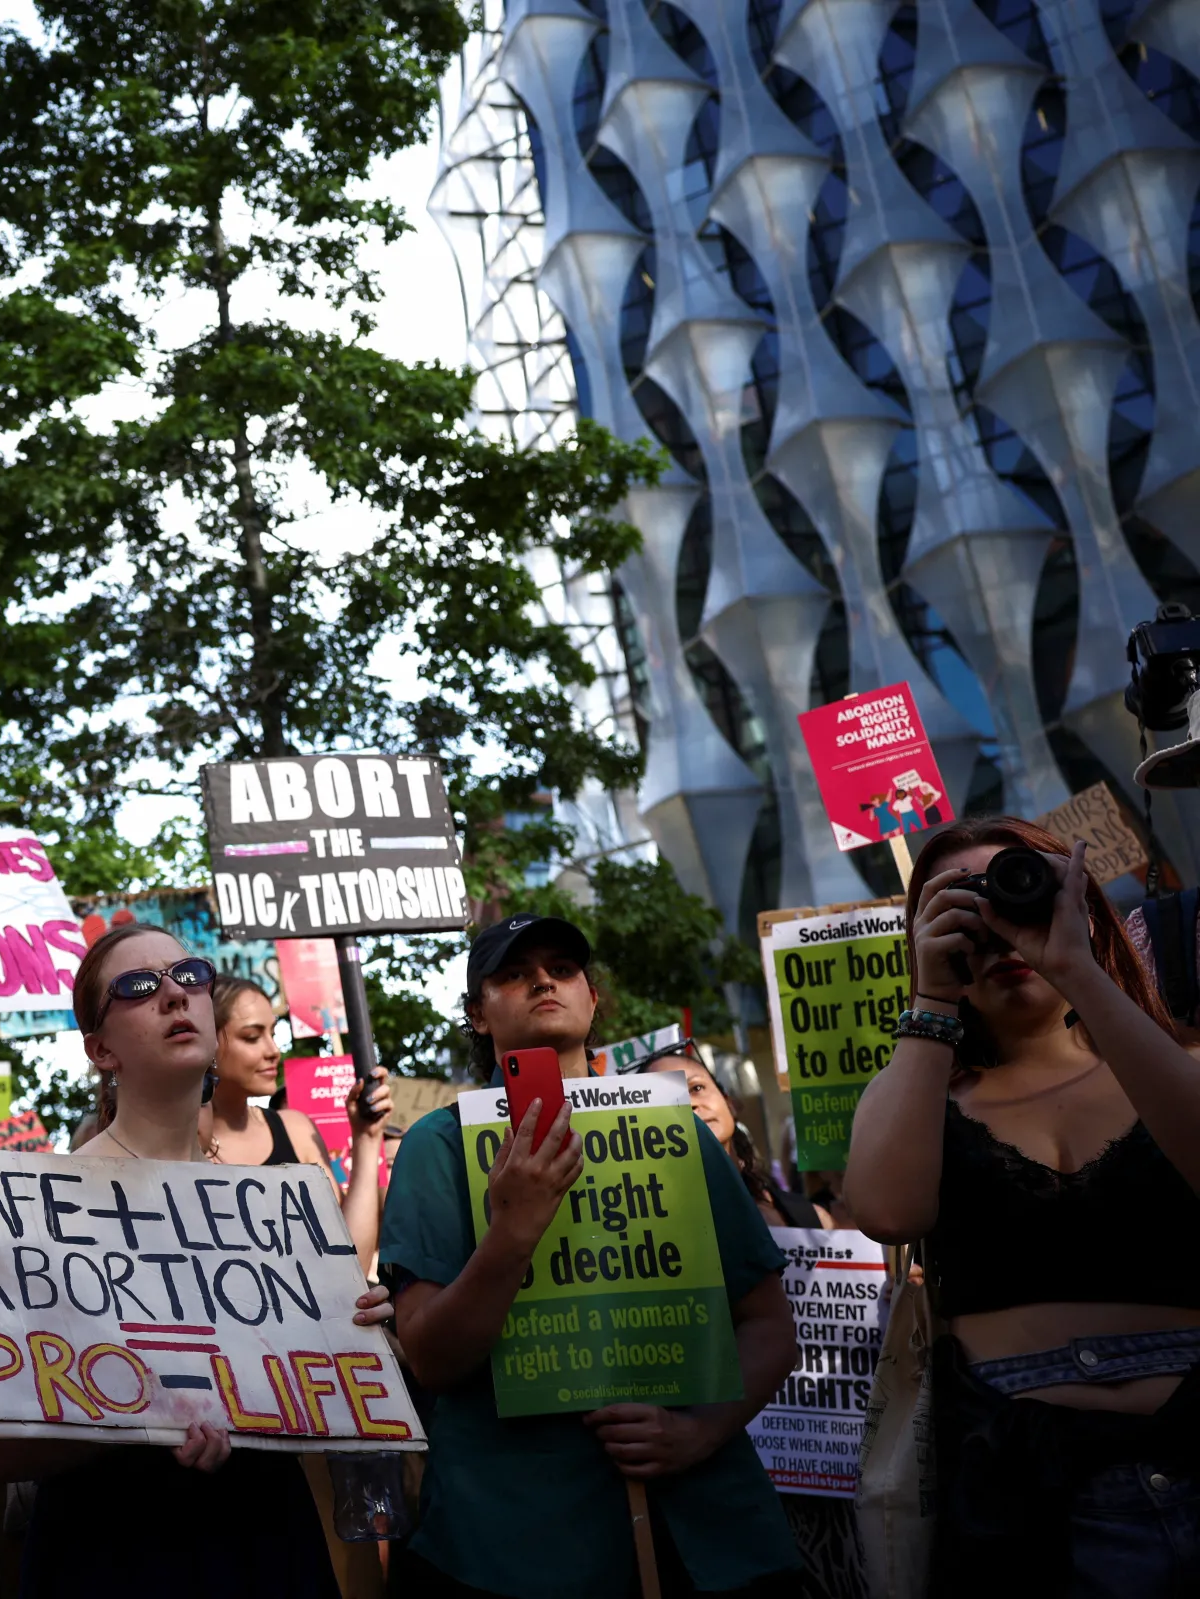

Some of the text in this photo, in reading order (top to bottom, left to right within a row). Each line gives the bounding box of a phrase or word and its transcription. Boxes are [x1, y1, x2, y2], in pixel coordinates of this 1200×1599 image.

[837, 694, 905, 723] ABORTION
[860, 705, 908, 728] RIGHTS
[836, 717, 911, 747] SOLIDARITY
[866, 727, 916, 750] MARCH
[229, 757, 431, 824] ABORT
[309, 828, 365, 858] THE
[799, 915, 907, 943] Socialist Work
[784, 952, 836, 989] Our
[790, 996, 842, 1033] Our
[796, 1043, 827, 1079] to
[576, 1086, 652, 1109] Worker
[583, 1115, 689, 1164] odies
[804, 1120, 846, 1145] right
[569, 1172, 668, 1232] right
[550, 1230, 682, 1286] decide
[810, 1281, 823, 1298] A
[827, 1282, 878, 1300] MASS
[588, 1309, 601, 1331] a
[610, 1296, 709, 1329] woman's
[843, 1326, 882, 1344] FOR
[504, 1338, 685, 1380] right to choose
[573, 1381, 680, 1400] socialistworker.co.uk
[762, 1416, 864, 1437] DEFEND THE RIGHT
[789, 1437, 823, 1454] WHEN
[825, 1438, 849, 1456] AND
[772, 1456, 787, 1470] TO
[788, 1457, 818, 1474] HAVE
